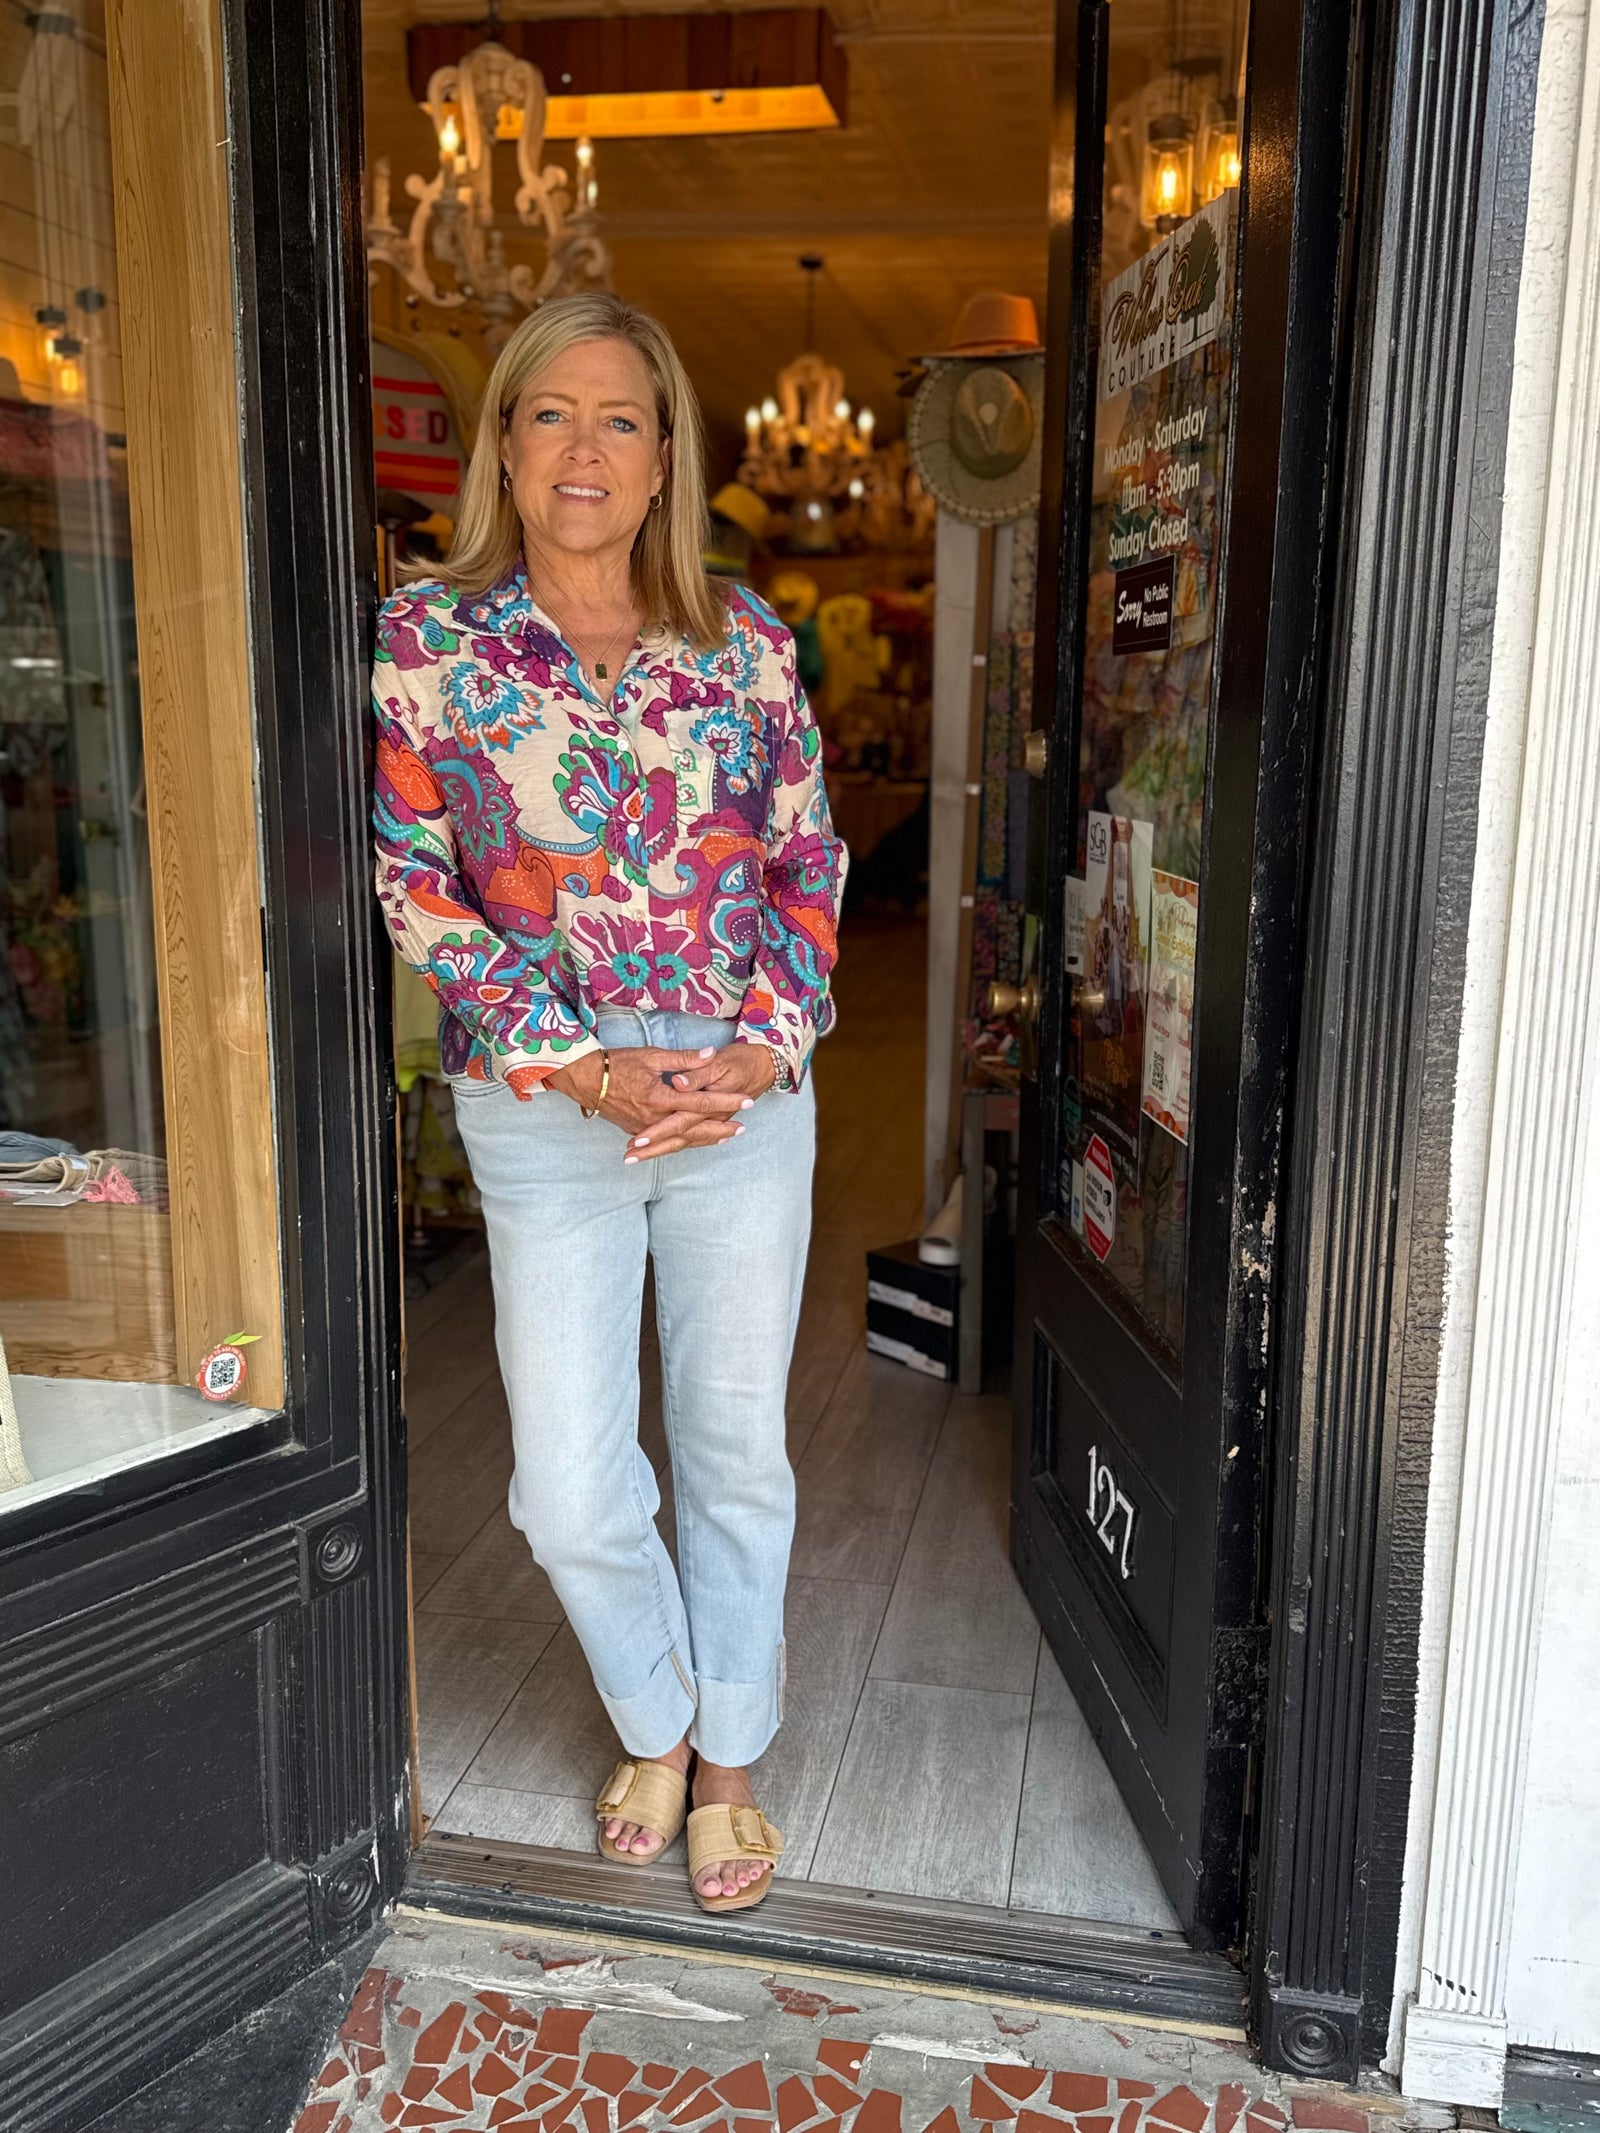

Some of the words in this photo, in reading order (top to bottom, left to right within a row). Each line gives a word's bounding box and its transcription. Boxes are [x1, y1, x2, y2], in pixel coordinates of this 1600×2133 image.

[1165, 240, 1214, 326] Oak
[1108, 335, 1176, 393] COUTURE
[1104, 435, 1145, 474] Monday
[1154, 405, 1208, 453] Saturday
[1156, 460, 1200, 503] 5:30pm
[1109, 527, 1147, 563] Sunday
[1149, 508, 1189, 551] Closed
[1116, 590, 1143, 629] Sorry
[1143, 611, 1168, 628] Restroom
[1144, 586, 1152, 604] No
[1152, 583, 1169, 602] Public
[1086, 1445, 1134, 1579] 127
